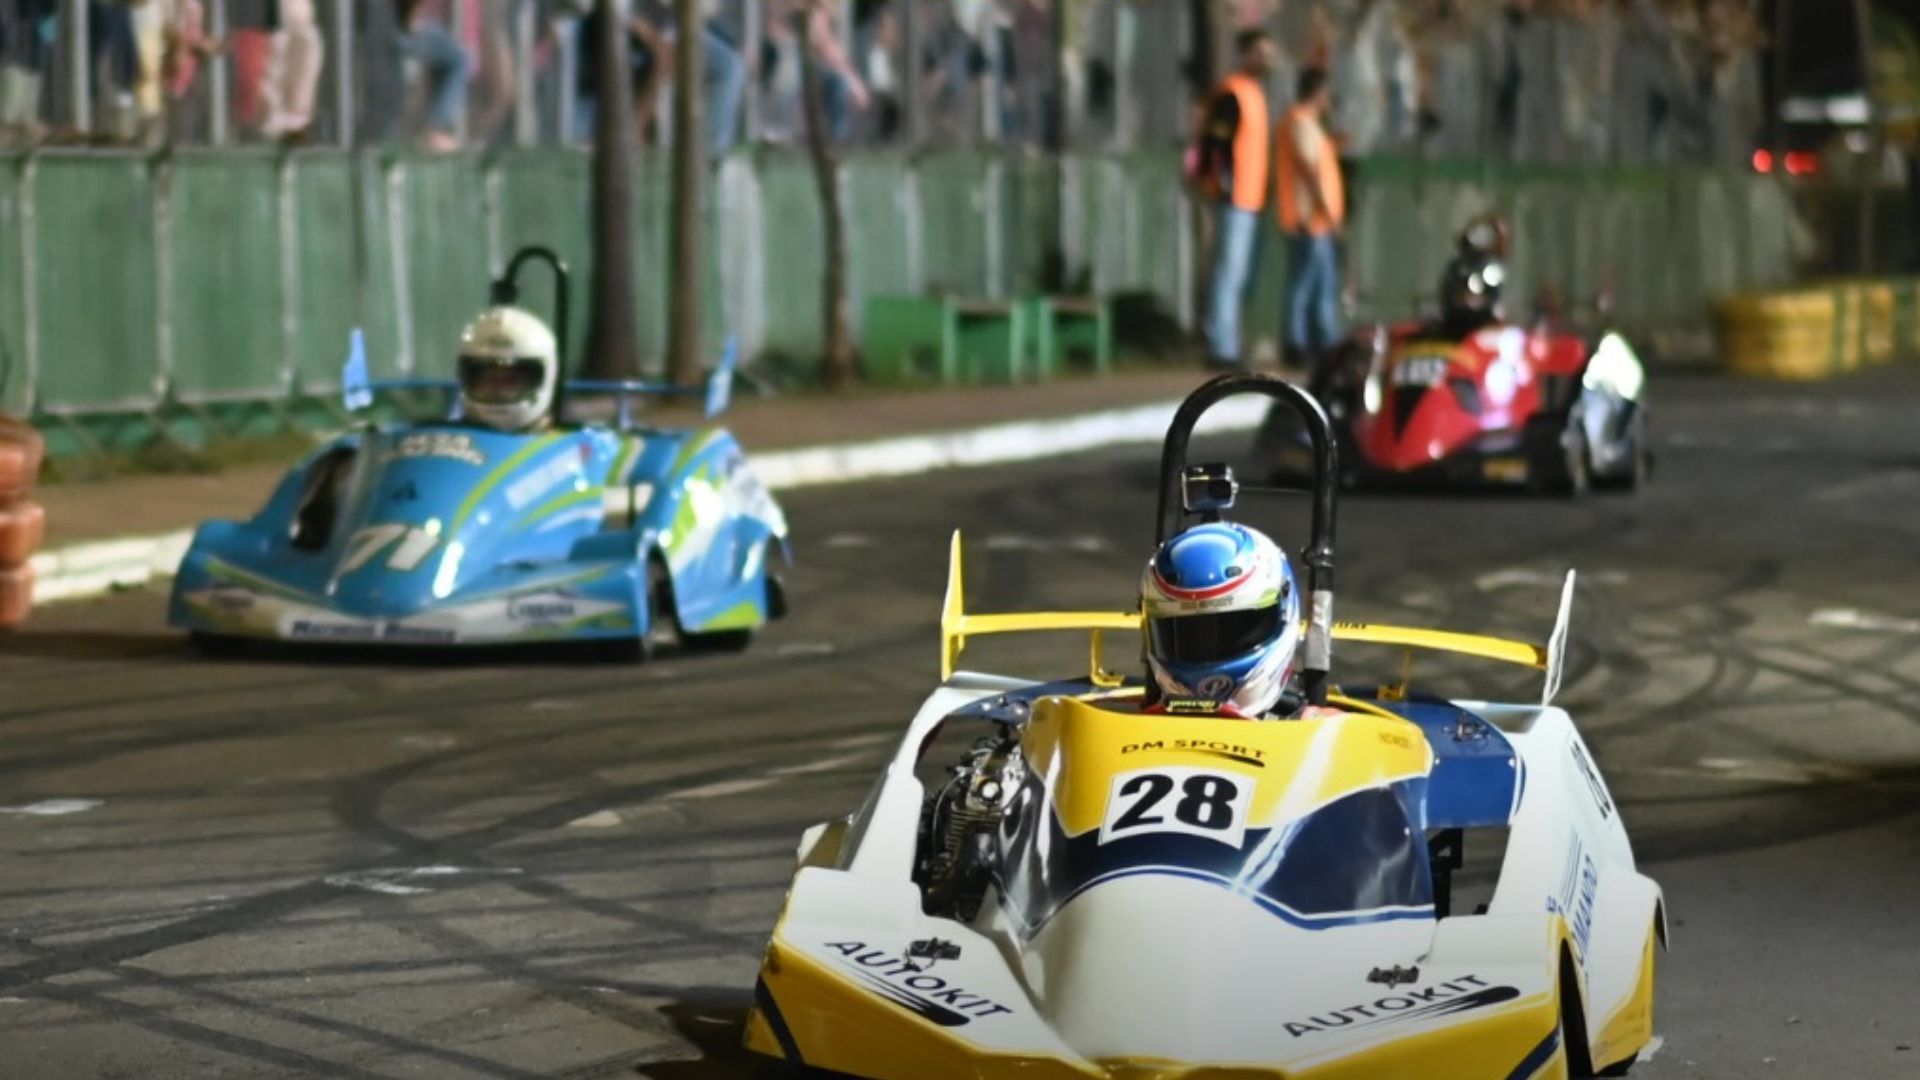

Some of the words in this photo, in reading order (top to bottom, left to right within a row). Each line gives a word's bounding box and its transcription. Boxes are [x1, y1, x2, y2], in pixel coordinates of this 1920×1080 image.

[340, 522, 440, 577] 71
[1121, 740, 1164, 755] DM
[1174, 740, 1266, 758] SPORT
[1111, 773, 1238, 832] 28
[825, 939, 1014, 1020] AUTOKIT
[1282, 973, 1489, 1038] AUTOKIT
